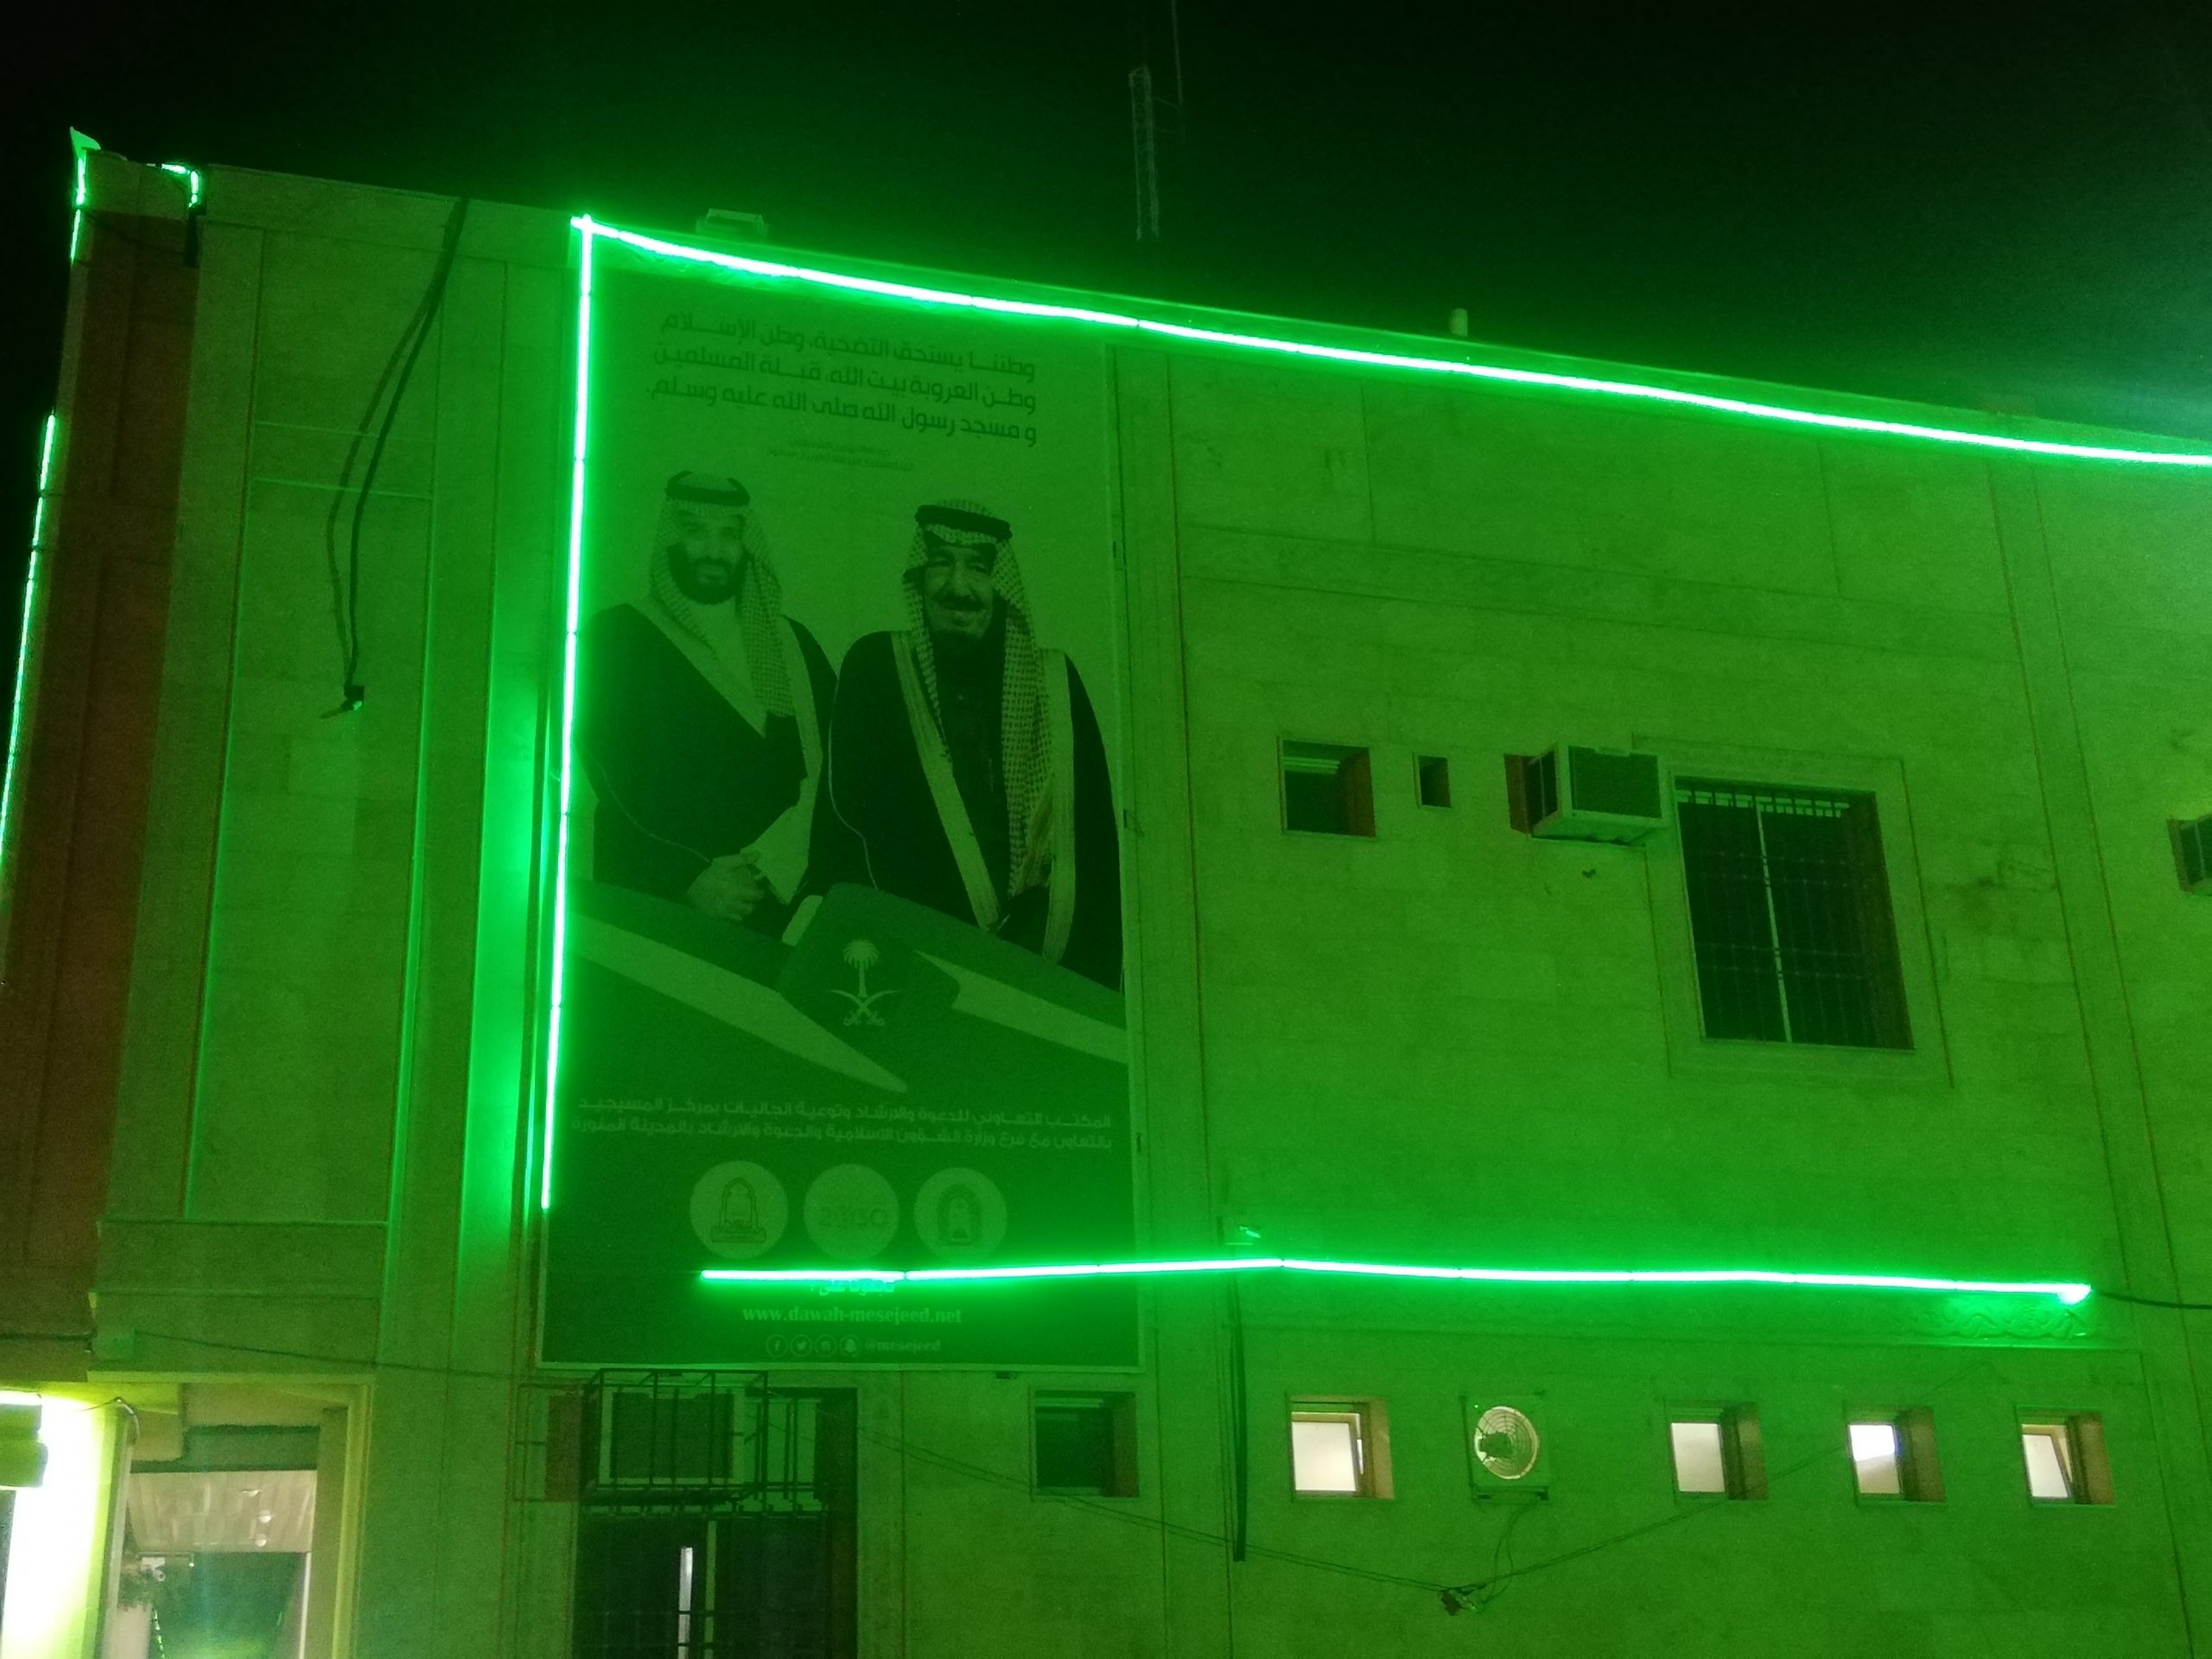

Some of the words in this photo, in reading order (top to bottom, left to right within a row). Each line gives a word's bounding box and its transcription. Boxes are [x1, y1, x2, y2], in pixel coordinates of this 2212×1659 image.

[760, 325, 805, 352] وطن
[867, 369, 906, 397] بيت
[910, 375, 978, 404] العروبة
[721, 385, 768, 410] عليه
[772, 391, 807, 412] الله
[812, 400, 859, 418] صلى
[982, 389, 1035, 415] وطن
[862, 403, 896, 423] الله
[901, 405, 956, 436] رسول
[742, 1306, 962, 1325] www.dawah-mesejeed.net
